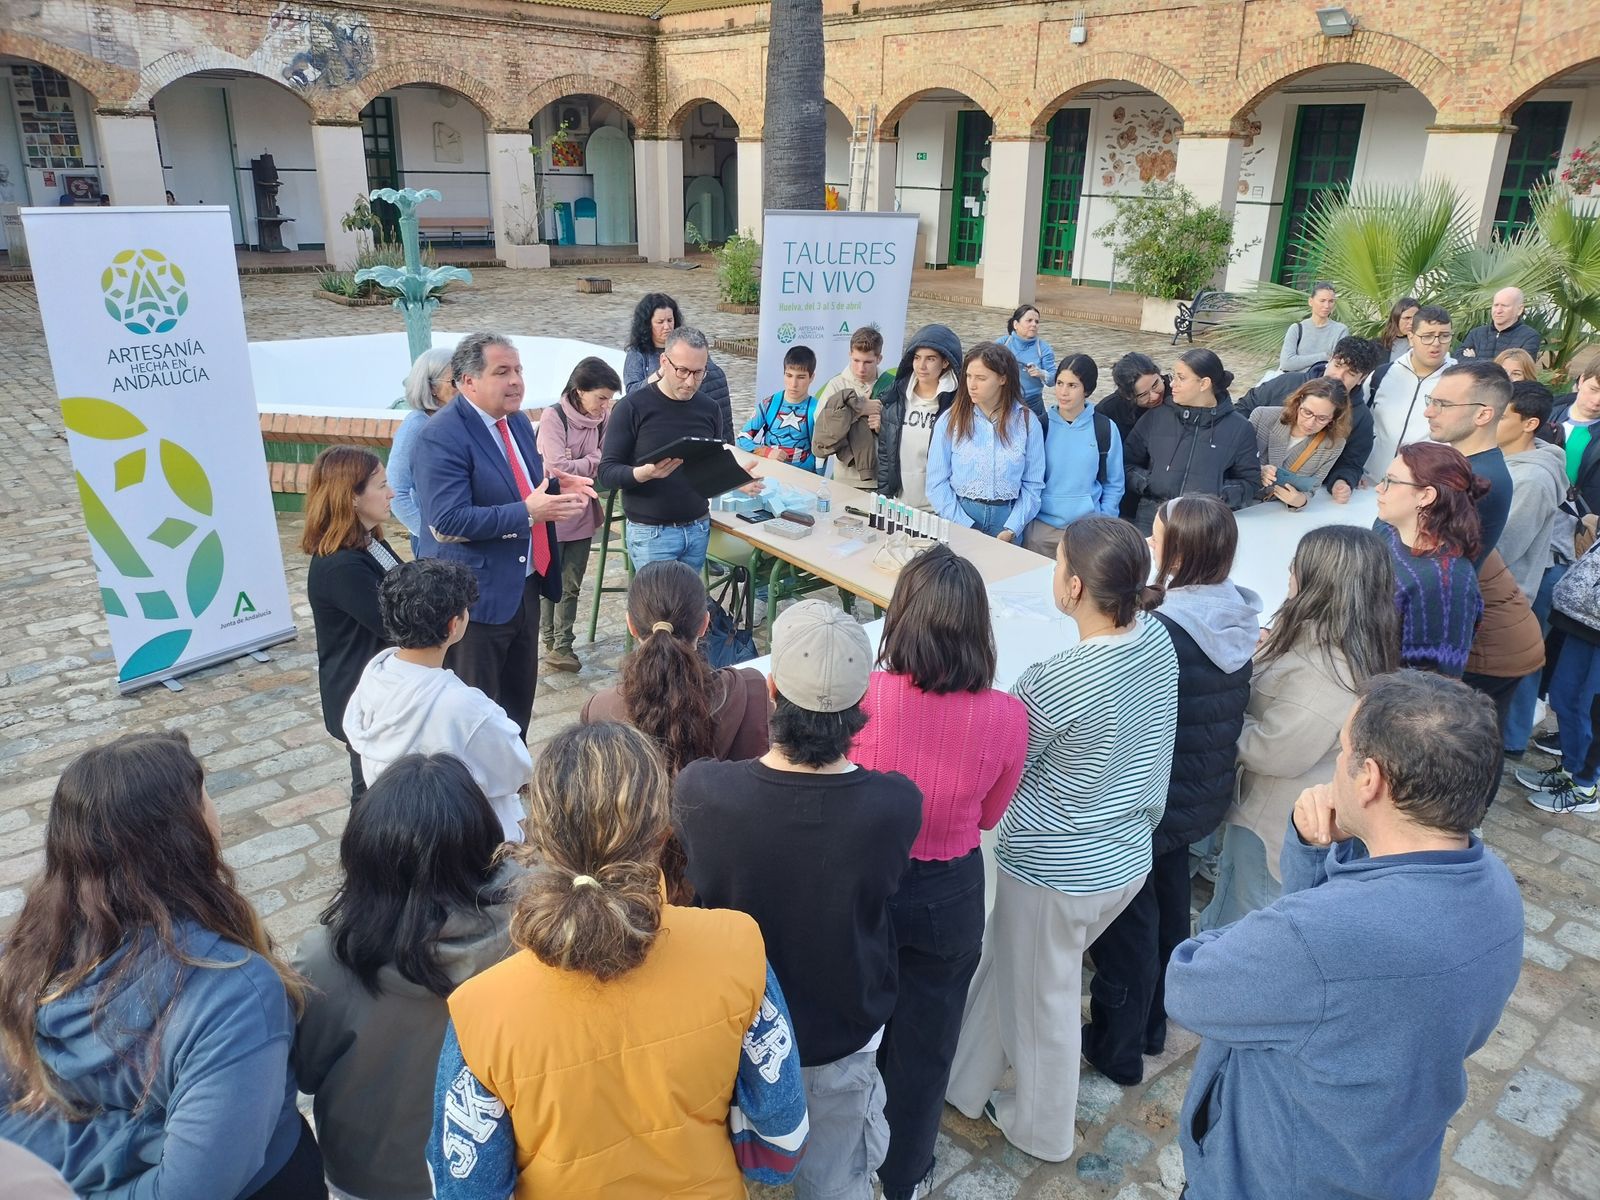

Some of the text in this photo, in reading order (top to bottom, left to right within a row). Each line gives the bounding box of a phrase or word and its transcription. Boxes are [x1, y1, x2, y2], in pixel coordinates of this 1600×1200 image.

[783, 241, 896, 265] TALLERES
[781, 270, 875, 294] EN VIVO
[804, 301, 815, 311] del
[816, 301, 821, 311] 3
[822, 301, 829, 311] al
[831, 301, 836, 311] 5
[836, 301, 845, 311] de
[846, 301, 862, 311] abril
[107, 338, 205, 365] ARTESANÍA
[130, 358, 187, 374] HECHA EN
[112, 365, 210, 393] ANDALUCÍA
[220, 620, 236, 630] Junta
[244, 609, 272, 621] Andalucía
